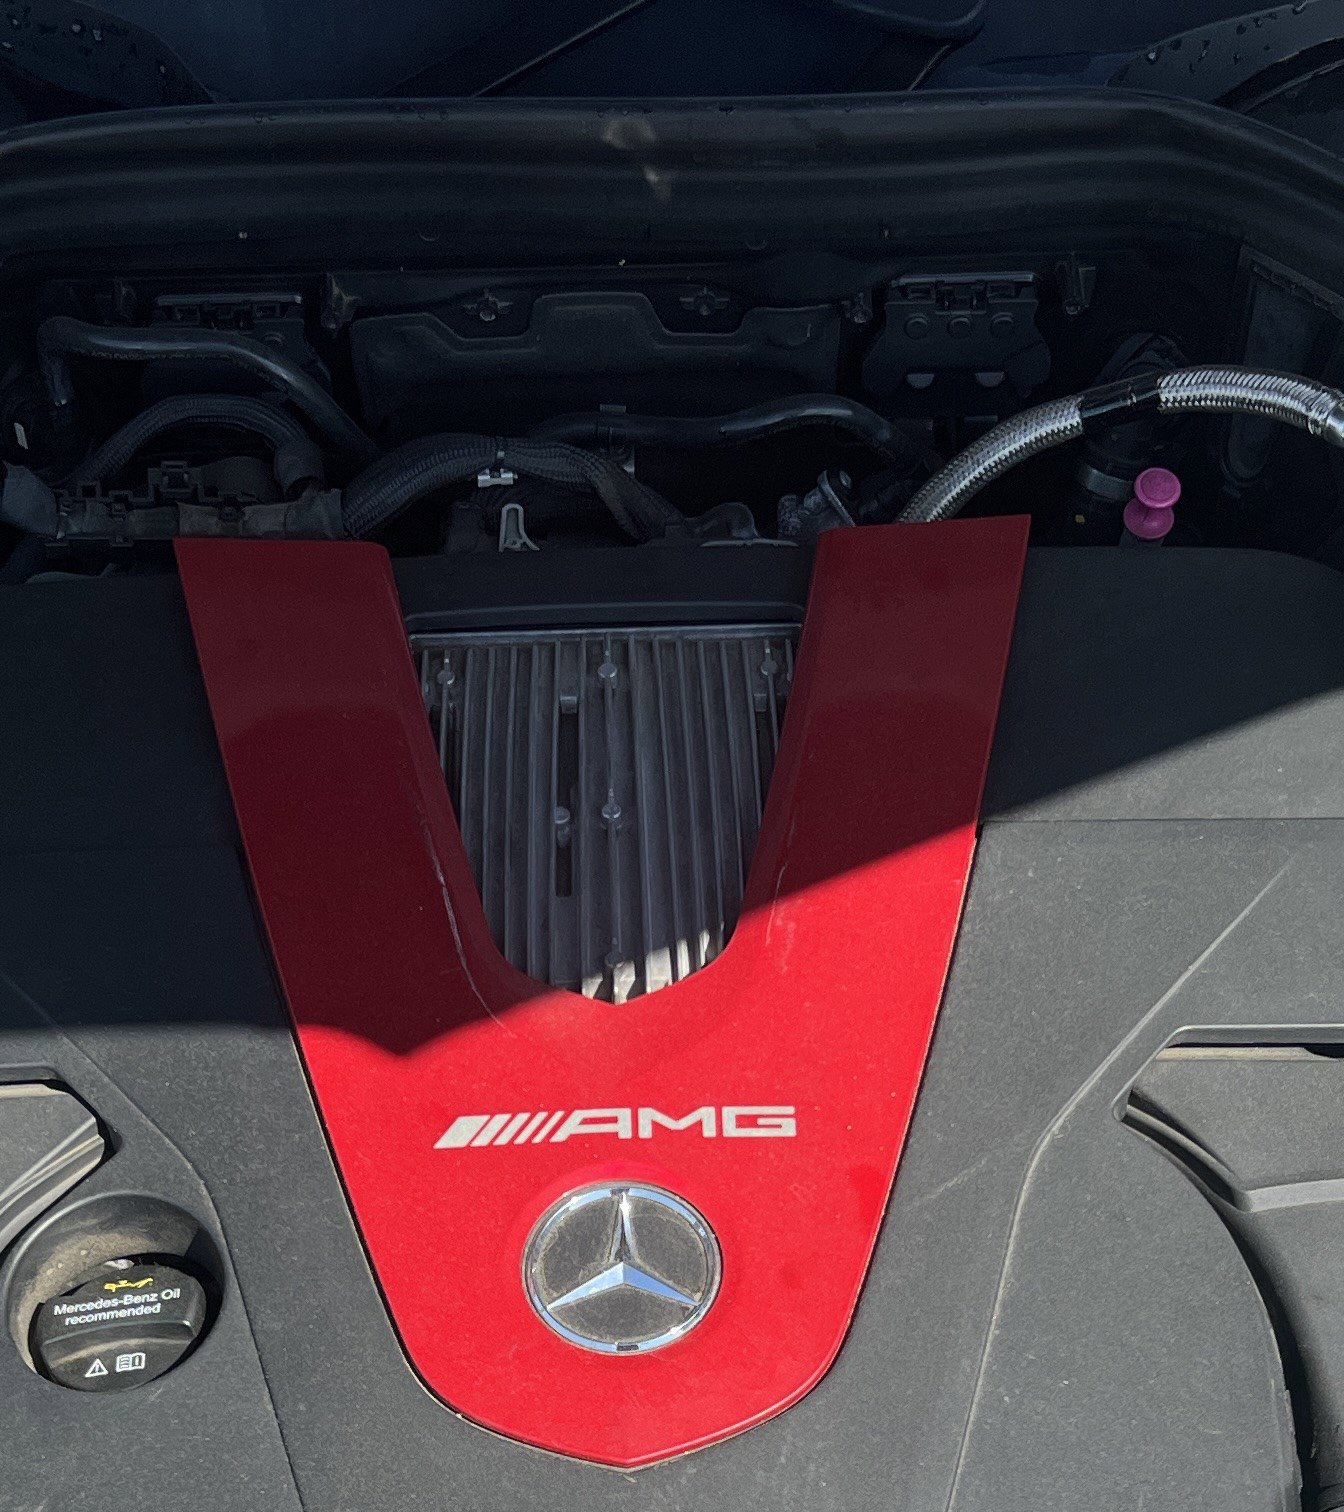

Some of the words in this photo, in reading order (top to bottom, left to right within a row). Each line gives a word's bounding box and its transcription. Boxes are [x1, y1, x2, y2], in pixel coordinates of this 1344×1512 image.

[551, 1105, 797, 1143] AMG
[53, 1291, 159, 1316] Mercedes-Benz
[161, 1287, 181, 1300] Oil
[64, 1302, 161, 1325] recommended
